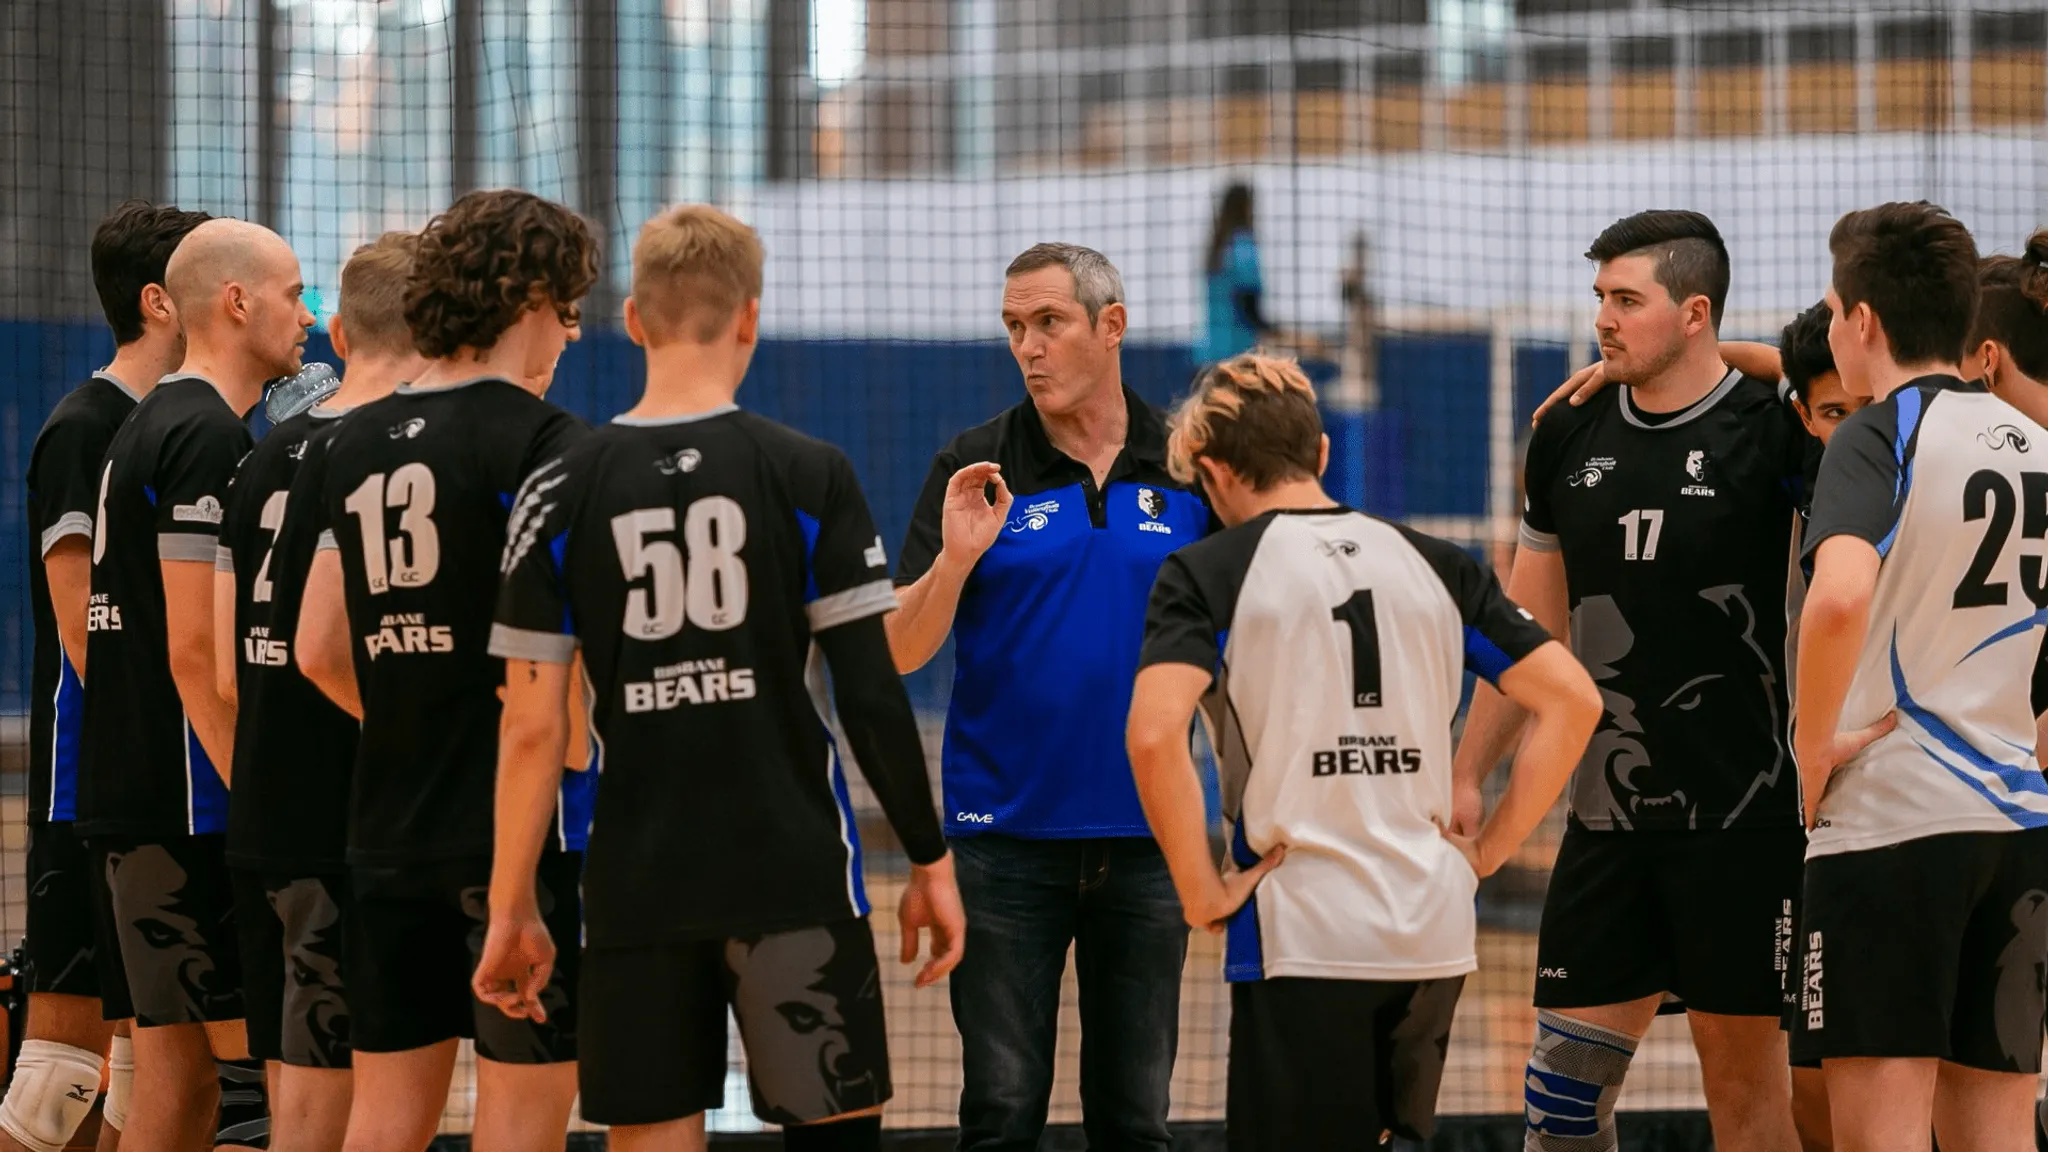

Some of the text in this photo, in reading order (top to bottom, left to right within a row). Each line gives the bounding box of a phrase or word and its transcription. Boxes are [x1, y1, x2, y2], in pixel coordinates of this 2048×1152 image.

[1680, 487, 1715, 497] BEARS
[345, 462, 440, 595] 13
[1138, 523, 1171, 535] BEARS
[1618, 509, 1664, 560] 17
[611, 495, 748, 641] 58
[1331, 588, 1382, 709] 1
[624, 668, 756, 714] BEARS
[1312, 748, 1421, 777] BEARS
[957, 811, 993, 824] GAME
[1807, 931, 1824, 1031] BEARS
